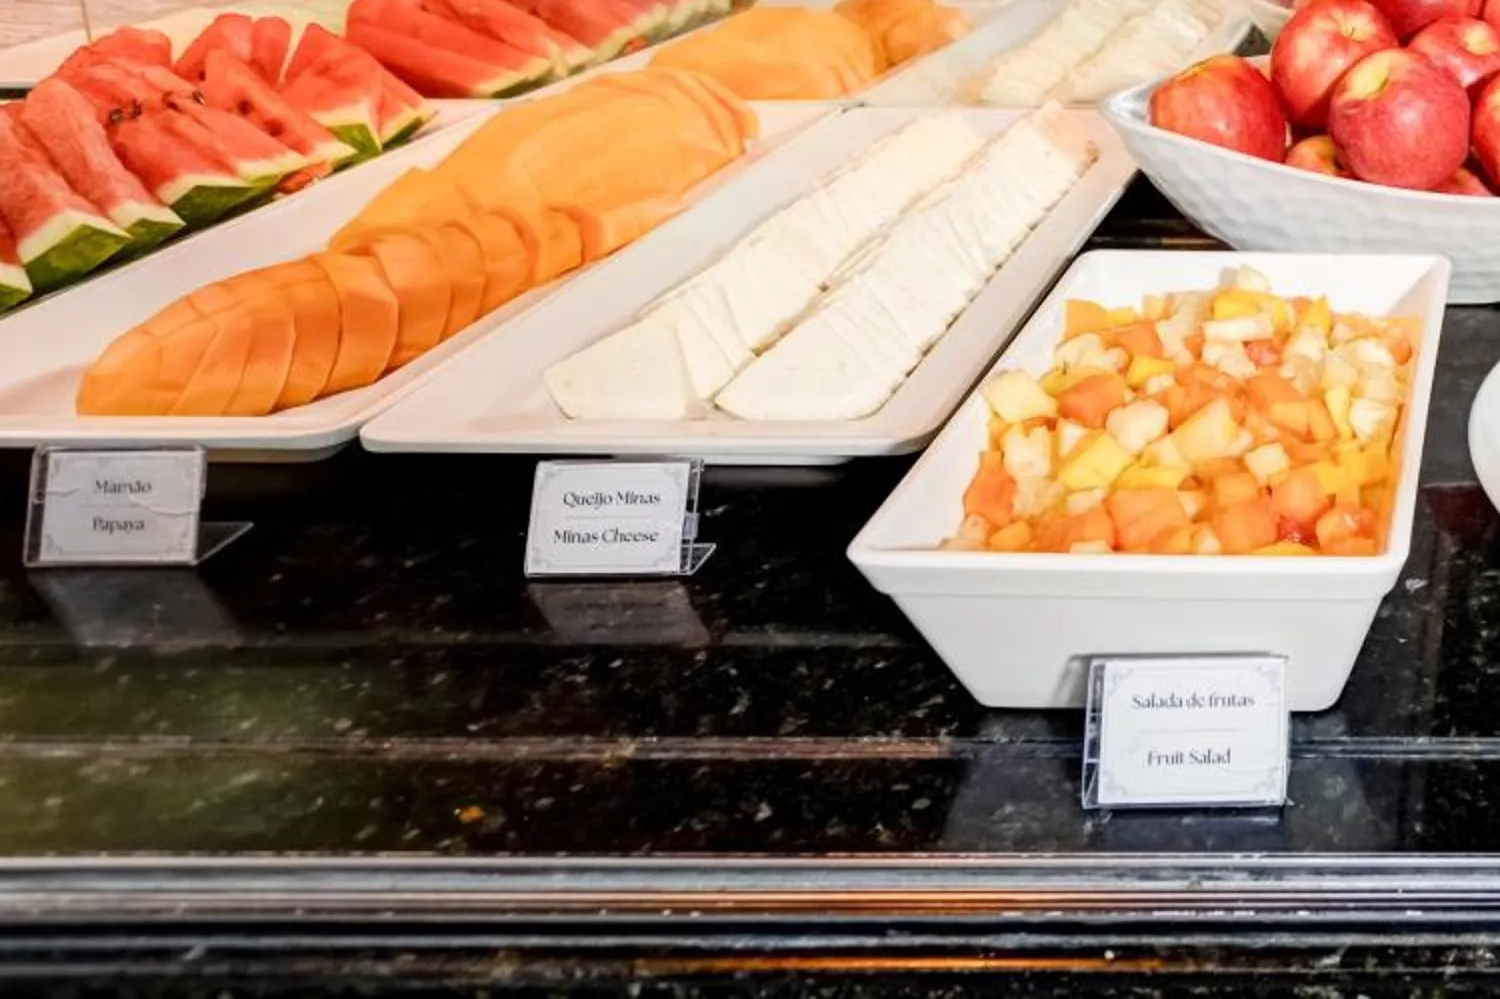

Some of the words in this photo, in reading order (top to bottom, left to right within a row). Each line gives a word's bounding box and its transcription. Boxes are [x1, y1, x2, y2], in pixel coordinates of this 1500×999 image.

[563, 491, 613, 509] Queijo
[616, 490, 661, 505] Minas
[92, 515, 145, 536] Papaya
[553, 529, 598, 545] Minas
[601, 528, 660, 544] Cheese
[1131, 691, 1184, 710] Salada
[1185, 691, 1206, 709] de
[1208, 691, 1256, 708] frutas
[1147, 749, 1184, 767] Fruit
[1189, 747, 1232, 766] Salad
